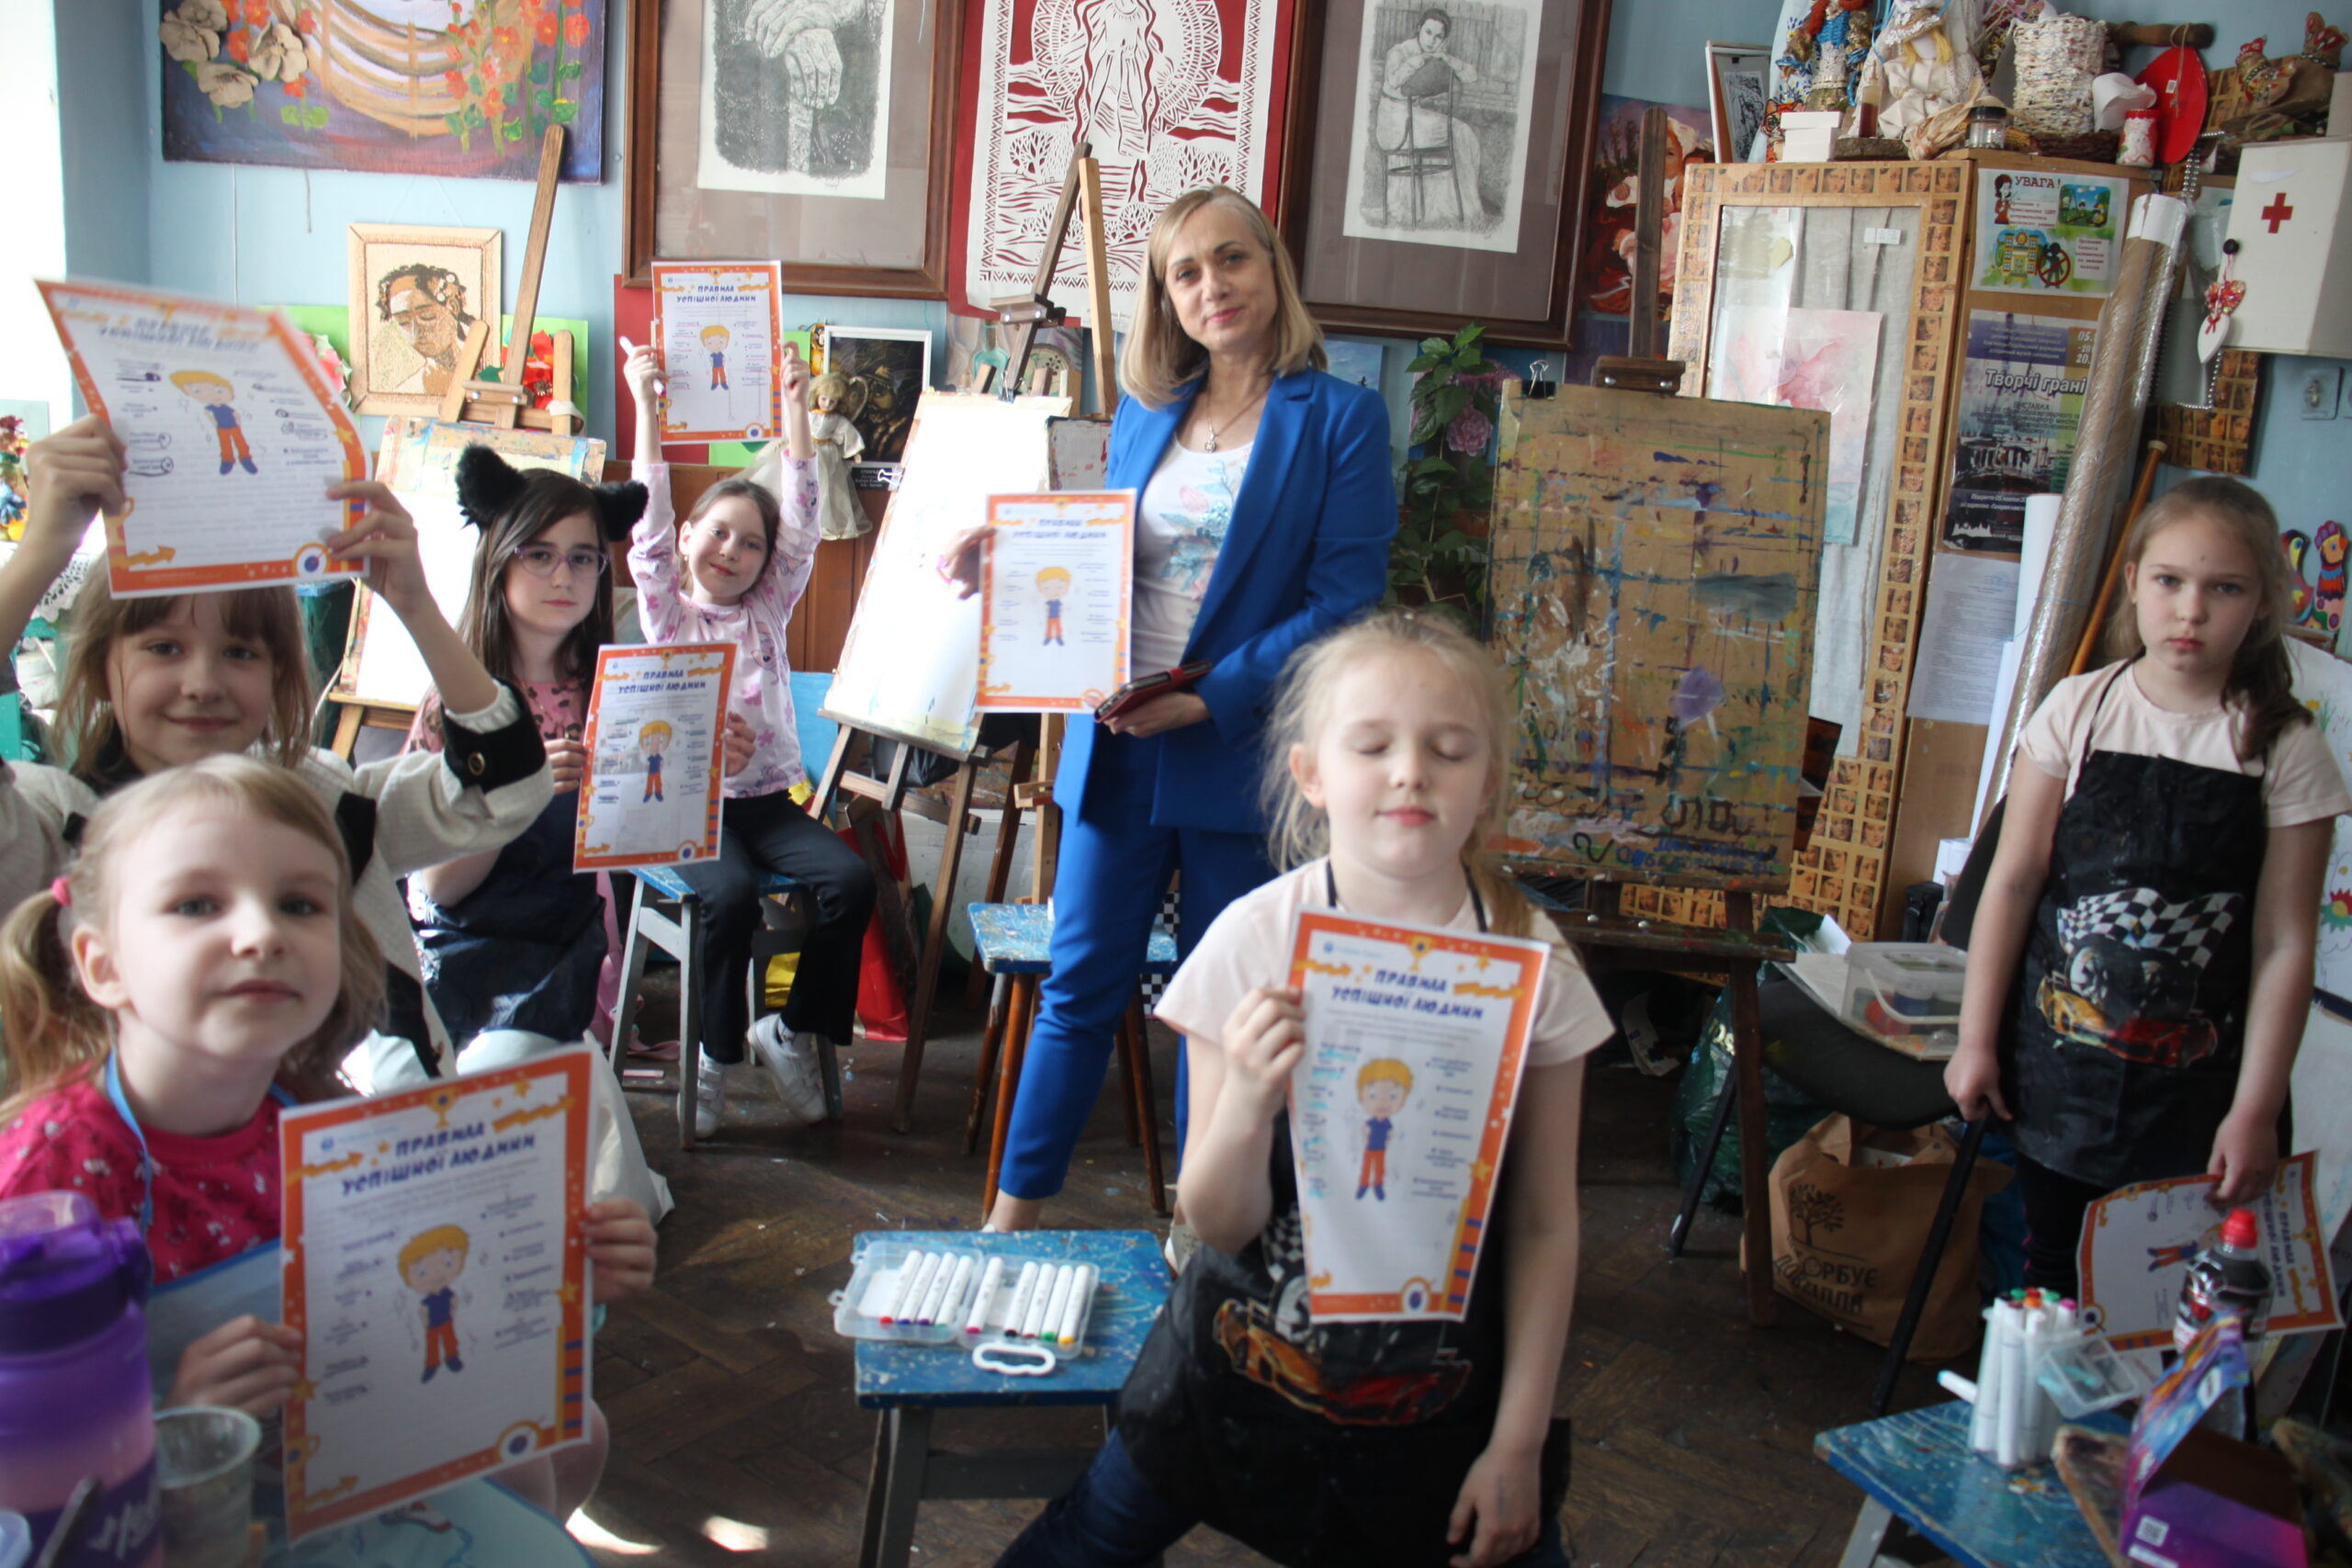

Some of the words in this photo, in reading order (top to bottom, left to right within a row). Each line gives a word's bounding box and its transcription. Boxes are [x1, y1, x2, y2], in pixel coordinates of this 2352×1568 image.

[2014, 175, 2061, 189] УВАГА!
[676, 294, 718, 302] УСПІШНОЇ
[1985, 369, 2041, 392] Творчі
[2041, 375, 2087, 399] грані
[643, 669, 684, 680] ПРАВИЛА
[618, 682, 664, 694] УСПІШНОЇ
[665, 681, 707, 692] ЛЮДИНИ
[1375, 969, 1447, 993] ПРАВИЛА
[1331, 986, 1412, 1008] УСПІШНОЇ
[1412, 997, 1484, 1020] ЛЮДИНИ
[395, 1122, 485, 1158] ПРАВИЛА
[341, 1151, 446, 1197] УСПІШНОЇ
[448, 1134, 536, 1168] ЛЮДИНИ
